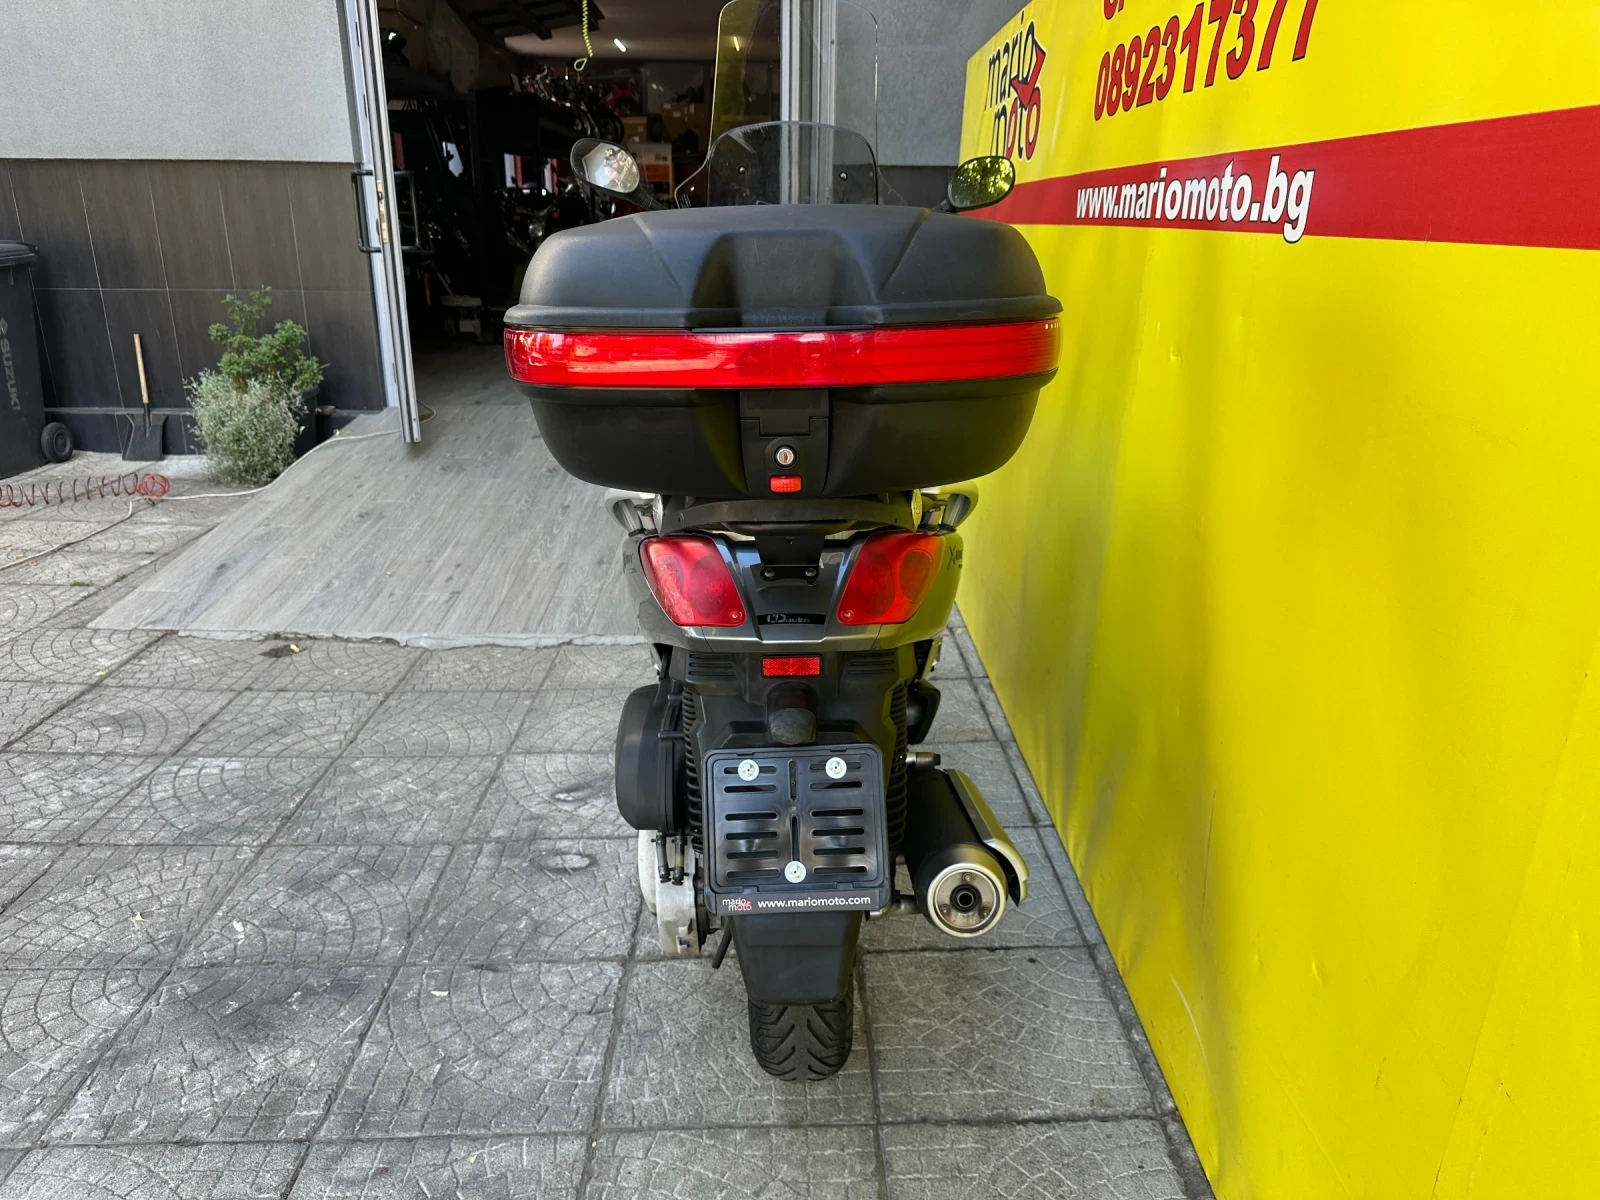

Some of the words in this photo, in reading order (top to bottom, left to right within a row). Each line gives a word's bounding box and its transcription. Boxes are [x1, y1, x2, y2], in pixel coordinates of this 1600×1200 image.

[984, 10, 1035, 111] mario
[989, 86, 1041, 161] moto
[1076, 154, 1316, 243] www.mariomoto.bg
[0, 338, 20, 410] SUZUKI
[722, 897, 746, 906] mario
[728, 903, 752, 911] moto
[757, 896, 871, 908] www.mariomoto.com
